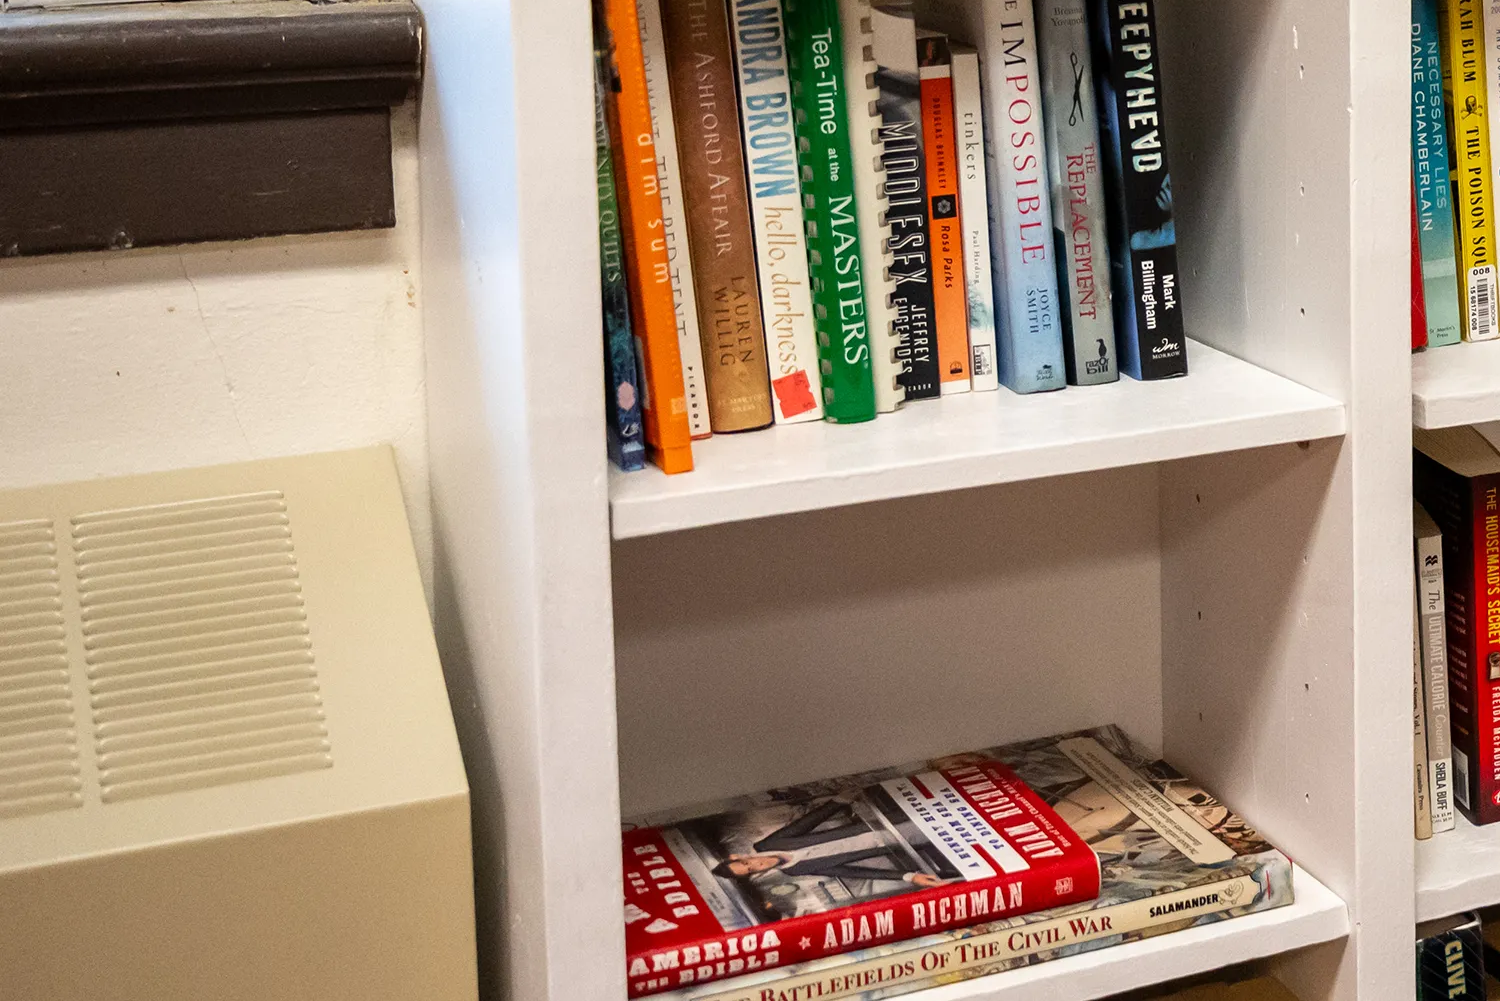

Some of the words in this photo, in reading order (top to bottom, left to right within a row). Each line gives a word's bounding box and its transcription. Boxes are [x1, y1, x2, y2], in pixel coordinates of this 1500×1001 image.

[688, 0, 708, 39] THE
[1411, 23, 1424, 83] DIANE
[1462, 39, 1476, 83] BLUM
[811, 27, 838, 135] Tea-Time
[1427, 42, 1443, 159] NECESSARY
[694, 52, 723, 165] ASHFORD
[745, 91, 797, 199] BROWN
[828, 148, 837, 160] at
[964, 112, 979, 180] tinkers
[1000, 19, 1046, 265] IMPOSSIBLE
[1084, 142, 1097, 175] THE
[1414, 91, 1433, 231] CHAMBERLAIN
[828, 161, 839, 182] the
[1434, 167, 1447, 209] LIES
[637, 133, 658, 196] dim
[648, 217, 670, 284] sum
[708, 173, 733, 257] AFFAIR
[880, 121, 928, 288] MIDDLESEX
[763, 207, 798, 268] hello,
[940, 225, 951, 253] Rosa
[1066, 153, 1097, 321] REPLACEMENT
[943, 258, 954, 289] Parks
[1141, 260, 1157, 330] Billingham
[1161, 274, 1177, 310] Mark
[712, 286, 736, 368] WILLIG
[730, 276, 756, 364] LAUREN
[770, 273, 804, 375] darkness
[911, 304, 929, 363] JEFFREY
[1026, 289, 1039, 334] SMITH
[1037, 288, 1052, 331] JOYCE
[1486, 487, 1497, 510] THE
[1486, 515, 1500, 595] HOUSEMAID'S
[1428, 589, 1440, 610] The
[1429, 615, 1442, 664] ULTIMATE
[1430, 665, 1445, 711] CALORIE
[1491, 686, 1500, 723] FREIDA
[1433, 712, 1445, 757] Counter
[1434, 762, 1446, 791] SHEILA
[1436, 791, 1447, 810] BUFF
[931, 801, 952, 818] SEA
[948, 820, 977, 844] FROM
[823, 909, 895, 949] ADAM
[911, 881, 1024, 931] RICHMAN
[1149, 893, 1219, 918] SALAMANDER
[629, 929, 782, 977] AMERICA
[634, 976, 669, 992] THE
[679, 950, 780, 985] EDIBLE
[759, 960, 915, 1001] BATTLEFIELDS
[920, 951, 950, 973] OF
[955, 940, 1001, 965] THE
[1007, 925, 1066, 952] CIVIL
[1067, 915, 1113, 938] WAR
[1445, 941, 1466, 1000] CLIVE
